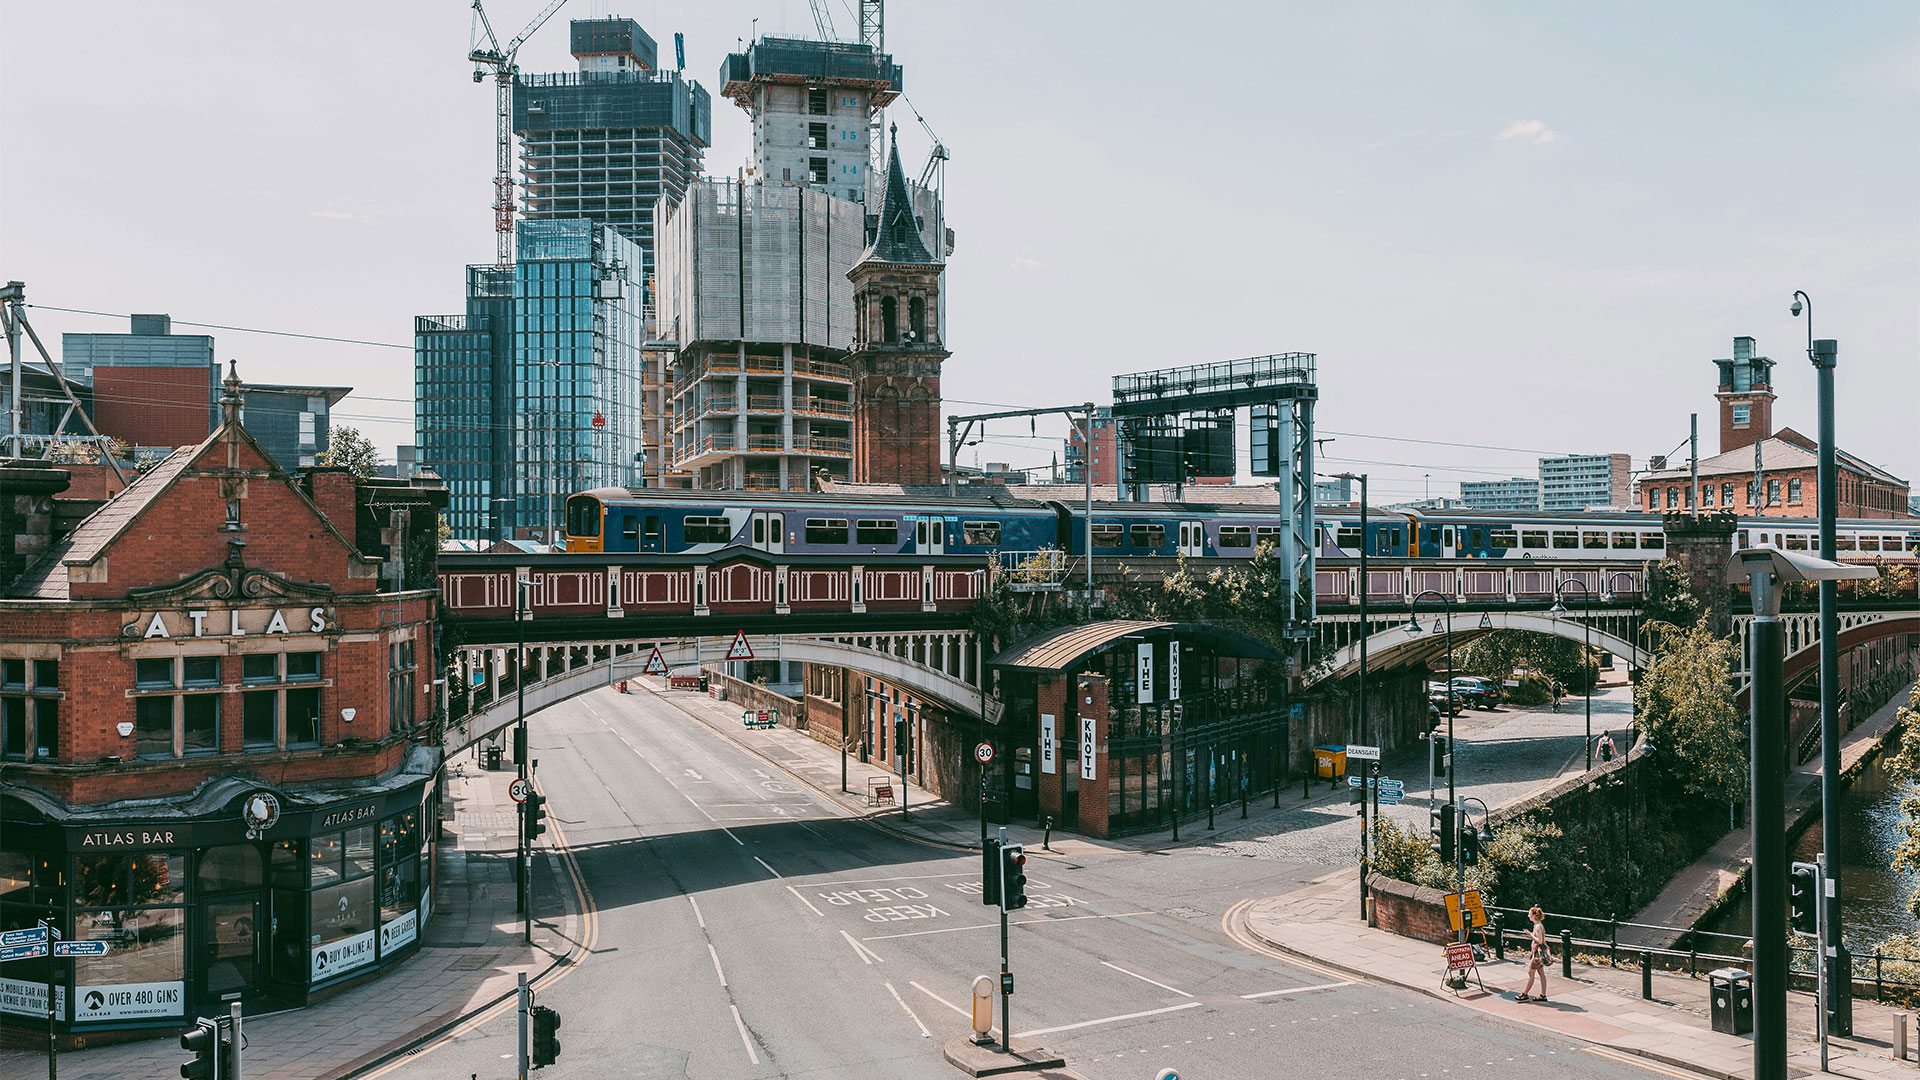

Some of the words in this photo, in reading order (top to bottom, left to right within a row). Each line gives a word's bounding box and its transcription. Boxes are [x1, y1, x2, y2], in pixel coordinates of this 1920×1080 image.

[842, 96, 857, 106] 16
[842, 130, 857, 140] 15
[842, 165, 857, 175] 14
[144, 607, 326, 639] ATLAS
[1142, 656, 1150, 691] THE
[1044, 727, 1052, 761] THE
[1084, 720, 1092, 778] KNOTT
[979, 748, 992, 758] 30
[1348, 748, 1378, 756] DEANSGATE
[324, 808, 355, 827] ATLAS
[357, 805, 376, 819] BAR
[83, 832, 135, 846] ATLAS
[142, 831, 174, 844] BAR
[818, 887, 928, 906] CLEAR
[330, 910, 356, 924] ATLAS
[863, 903, 951, 923] KEEP
[329, 949, 341, 963] BUY
[343, 940, 365, 959] ON-LINE
[366, 938, 373, 951] AT
[1451, 953, 1470, 961] AHEAD
[1450, 960, 1473, 969] CLOSED
[5, 983, 23, 996] MOBILE
[25, 986, 35, 997] BAR
[3, 995, 19, 1006] VENUE
[20, 997, 27, 1007] OF
[28, 998, 42, 1009] YOUR
[108, 992, 131, 1006] OVER
[135, 991, 153, 1005] 480
[157, 989, 178, 1004] GINS
